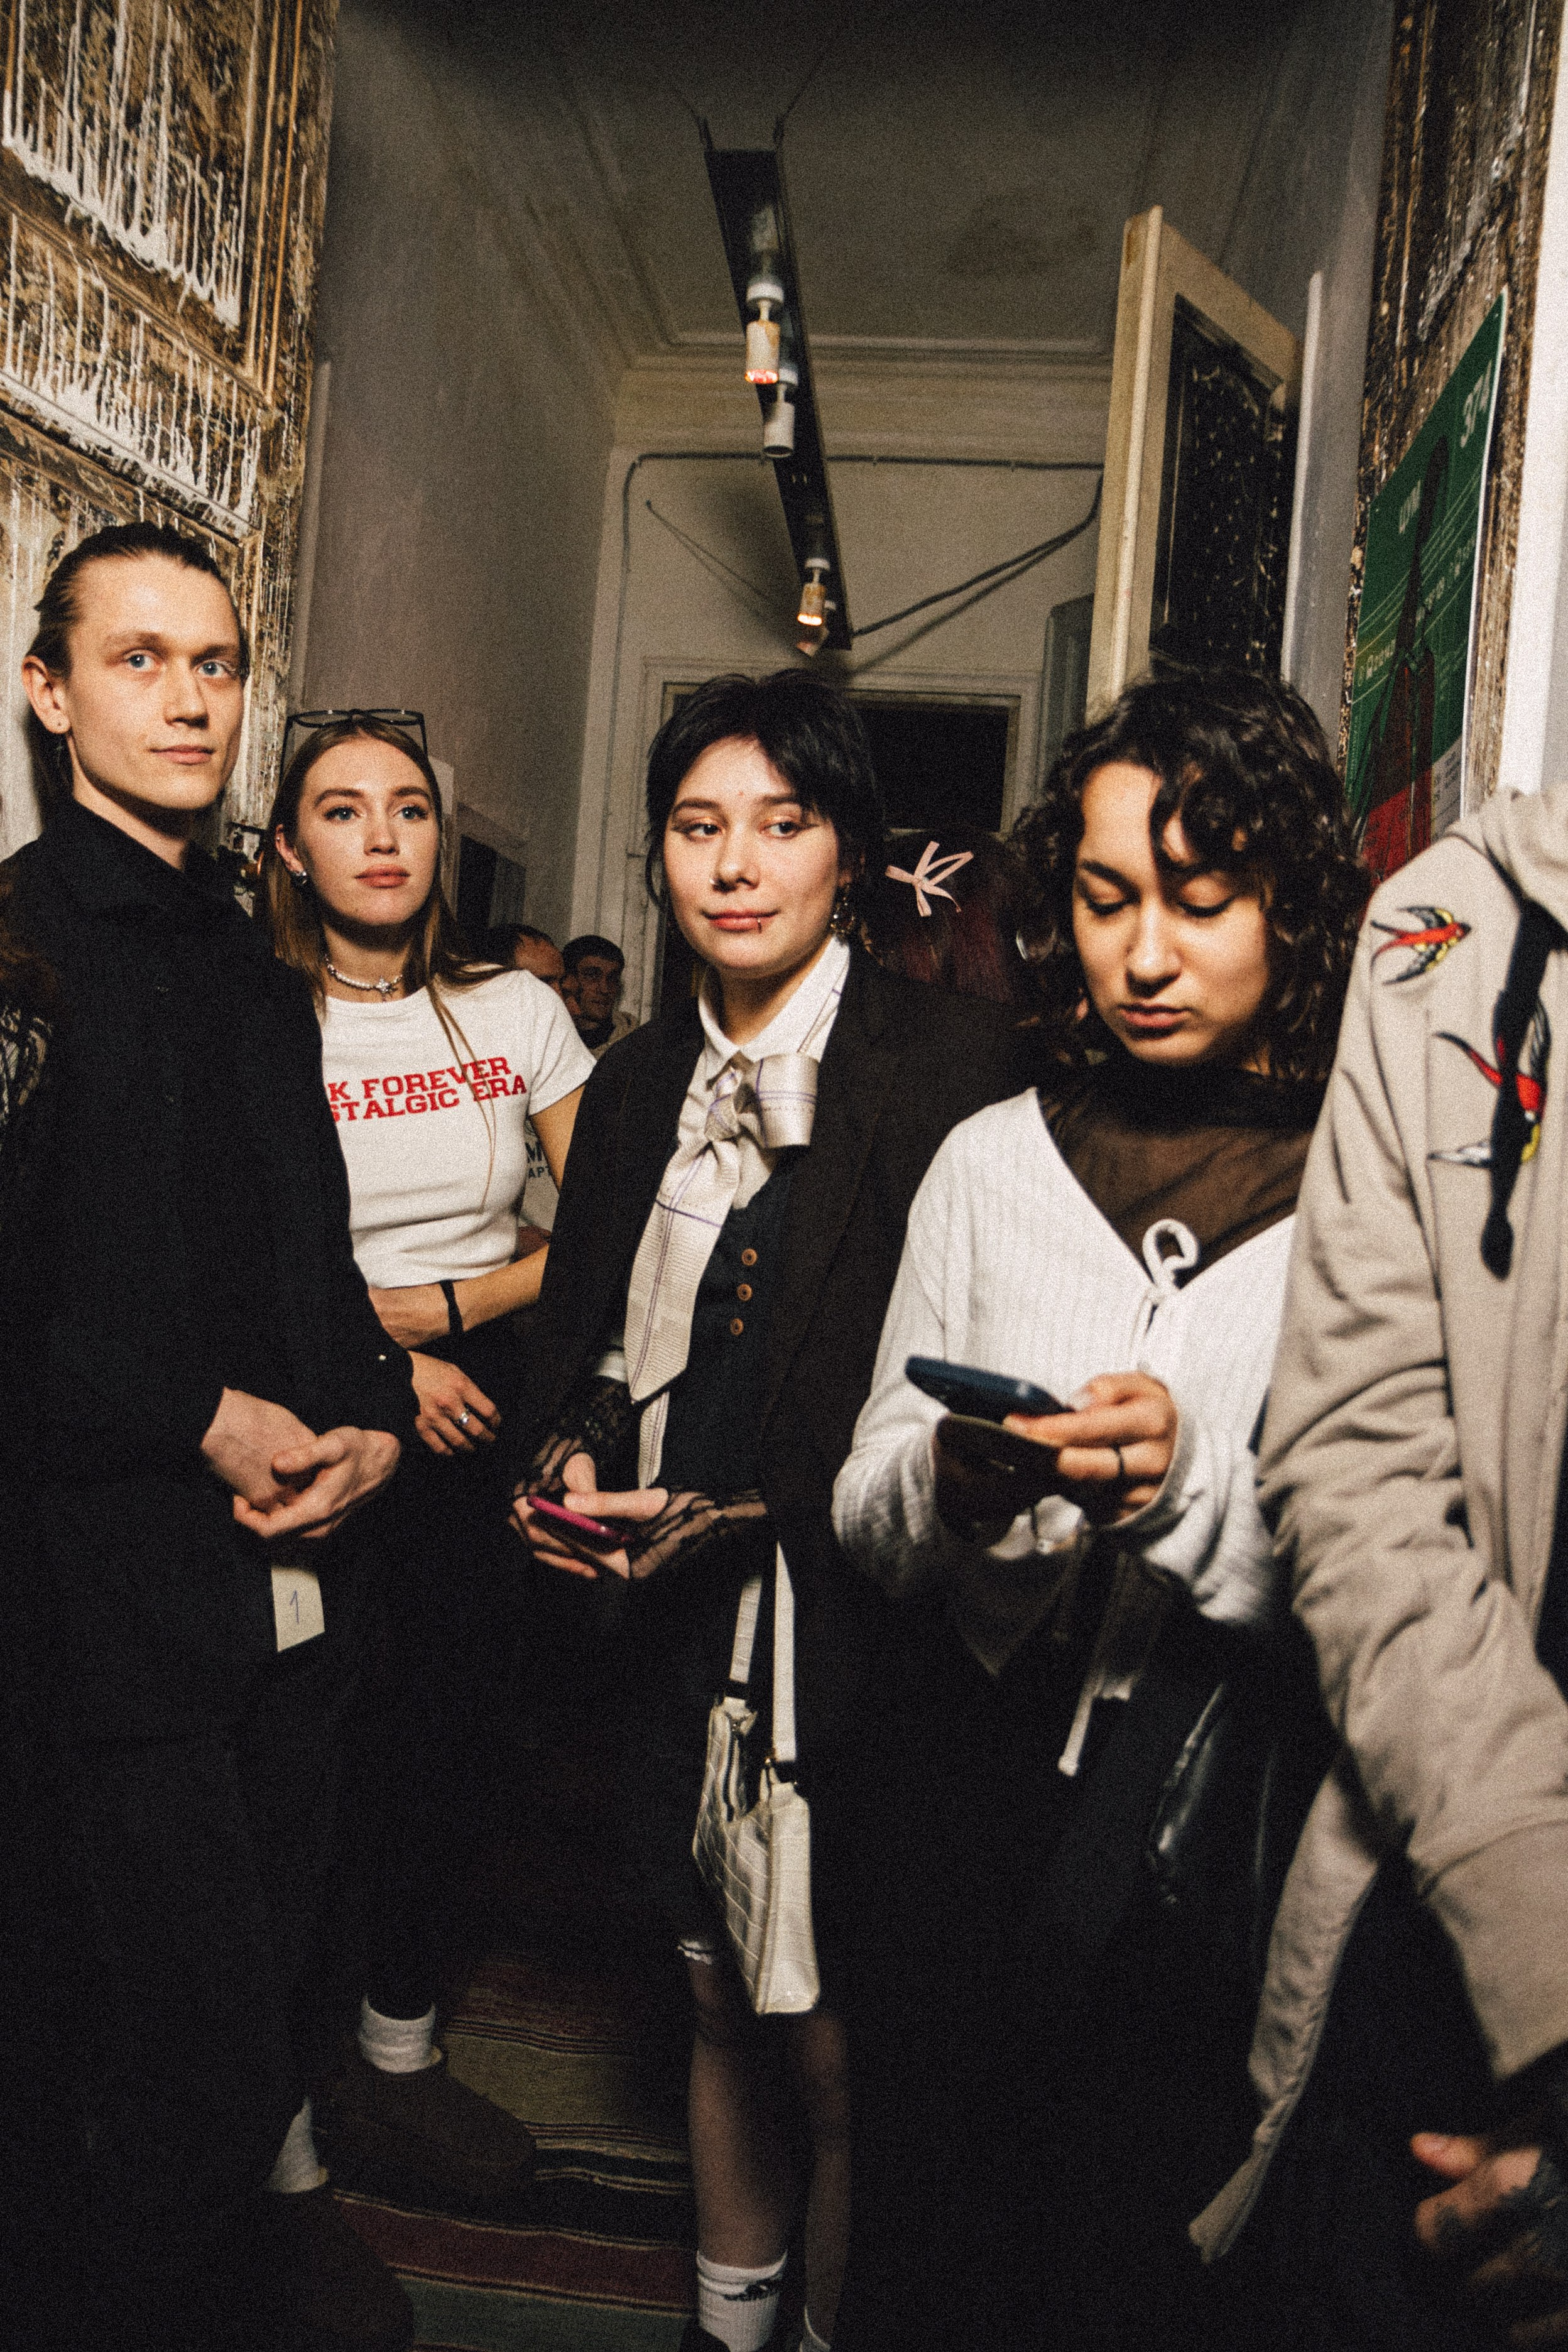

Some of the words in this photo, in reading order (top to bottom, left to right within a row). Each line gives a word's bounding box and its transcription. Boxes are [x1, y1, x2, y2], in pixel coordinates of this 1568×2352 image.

[361, 1057, 511, 1099] FOREVER
[471, 1075, 527, 1102] ERA
[290, 1589, 300, 1625] 1
